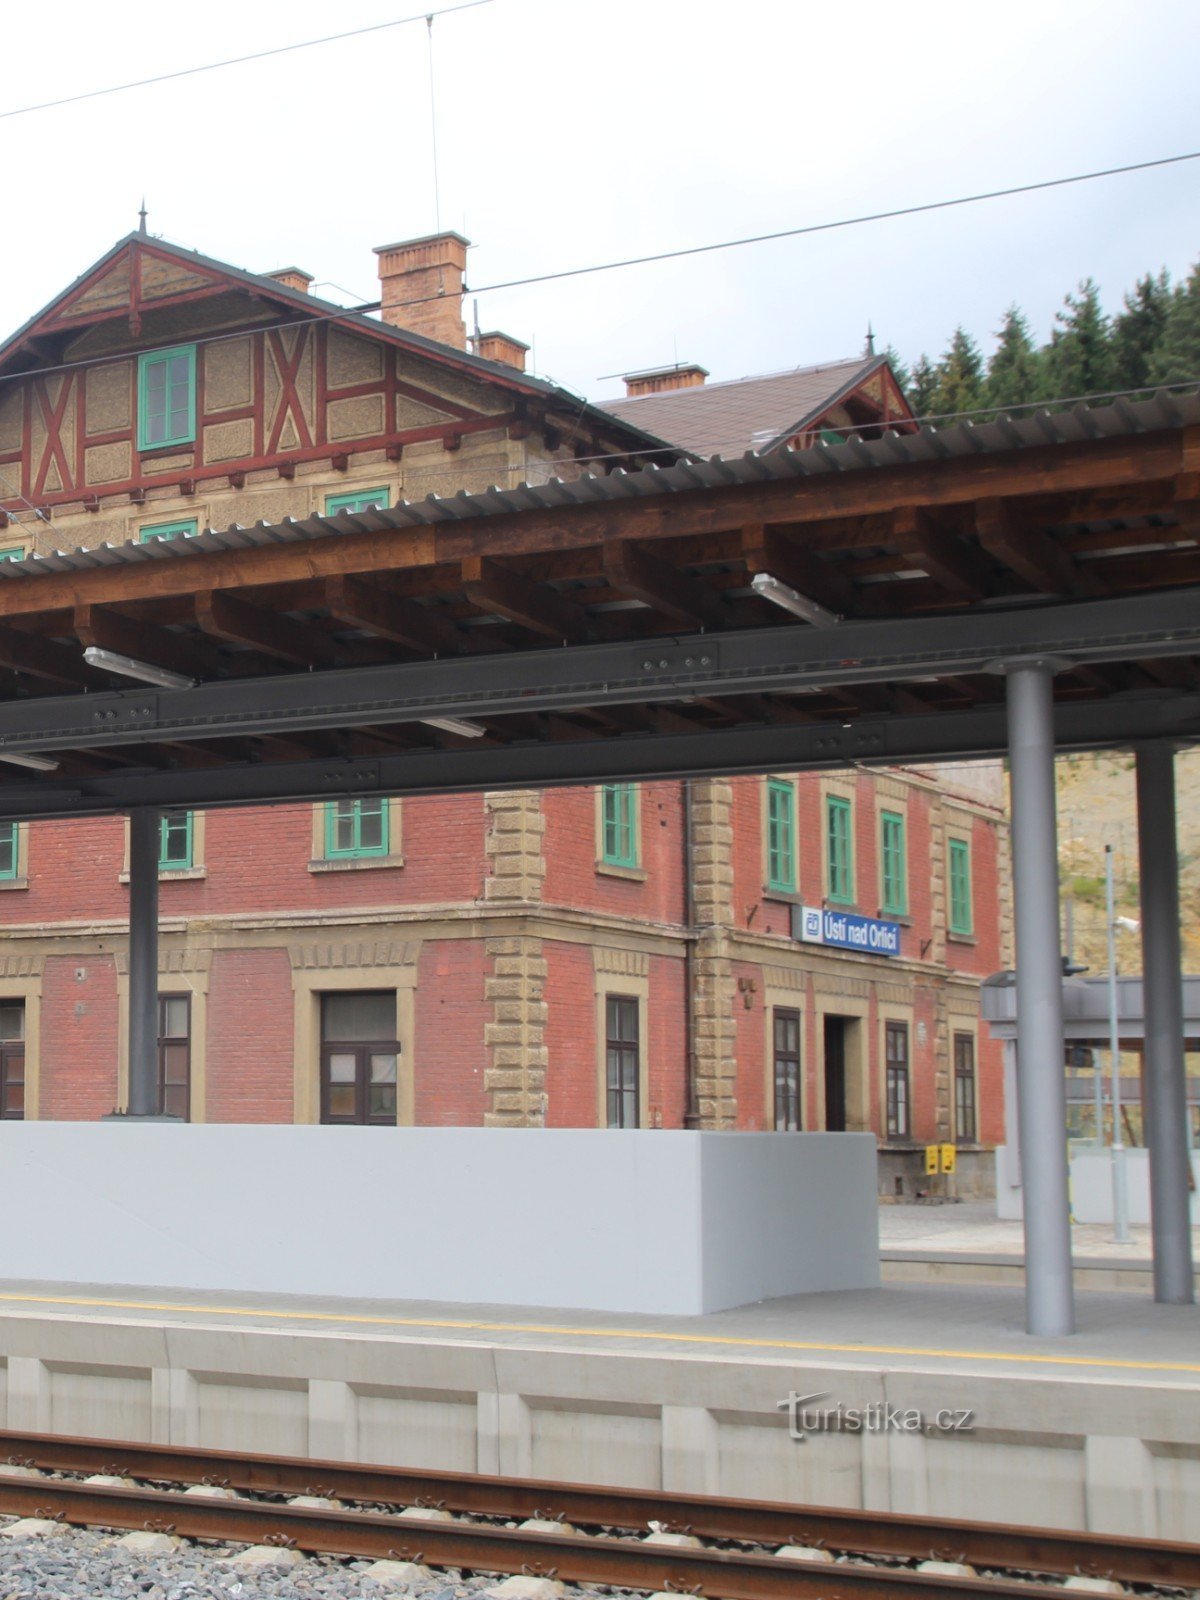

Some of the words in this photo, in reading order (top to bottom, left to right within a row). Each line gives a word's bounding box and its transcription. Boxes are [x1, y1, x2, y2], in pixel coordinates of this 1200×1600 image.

[824, 911, 847, 941] Ústí
[847, 923, 868, 945] nad
[869, 924, 897, 950] Orlicí
